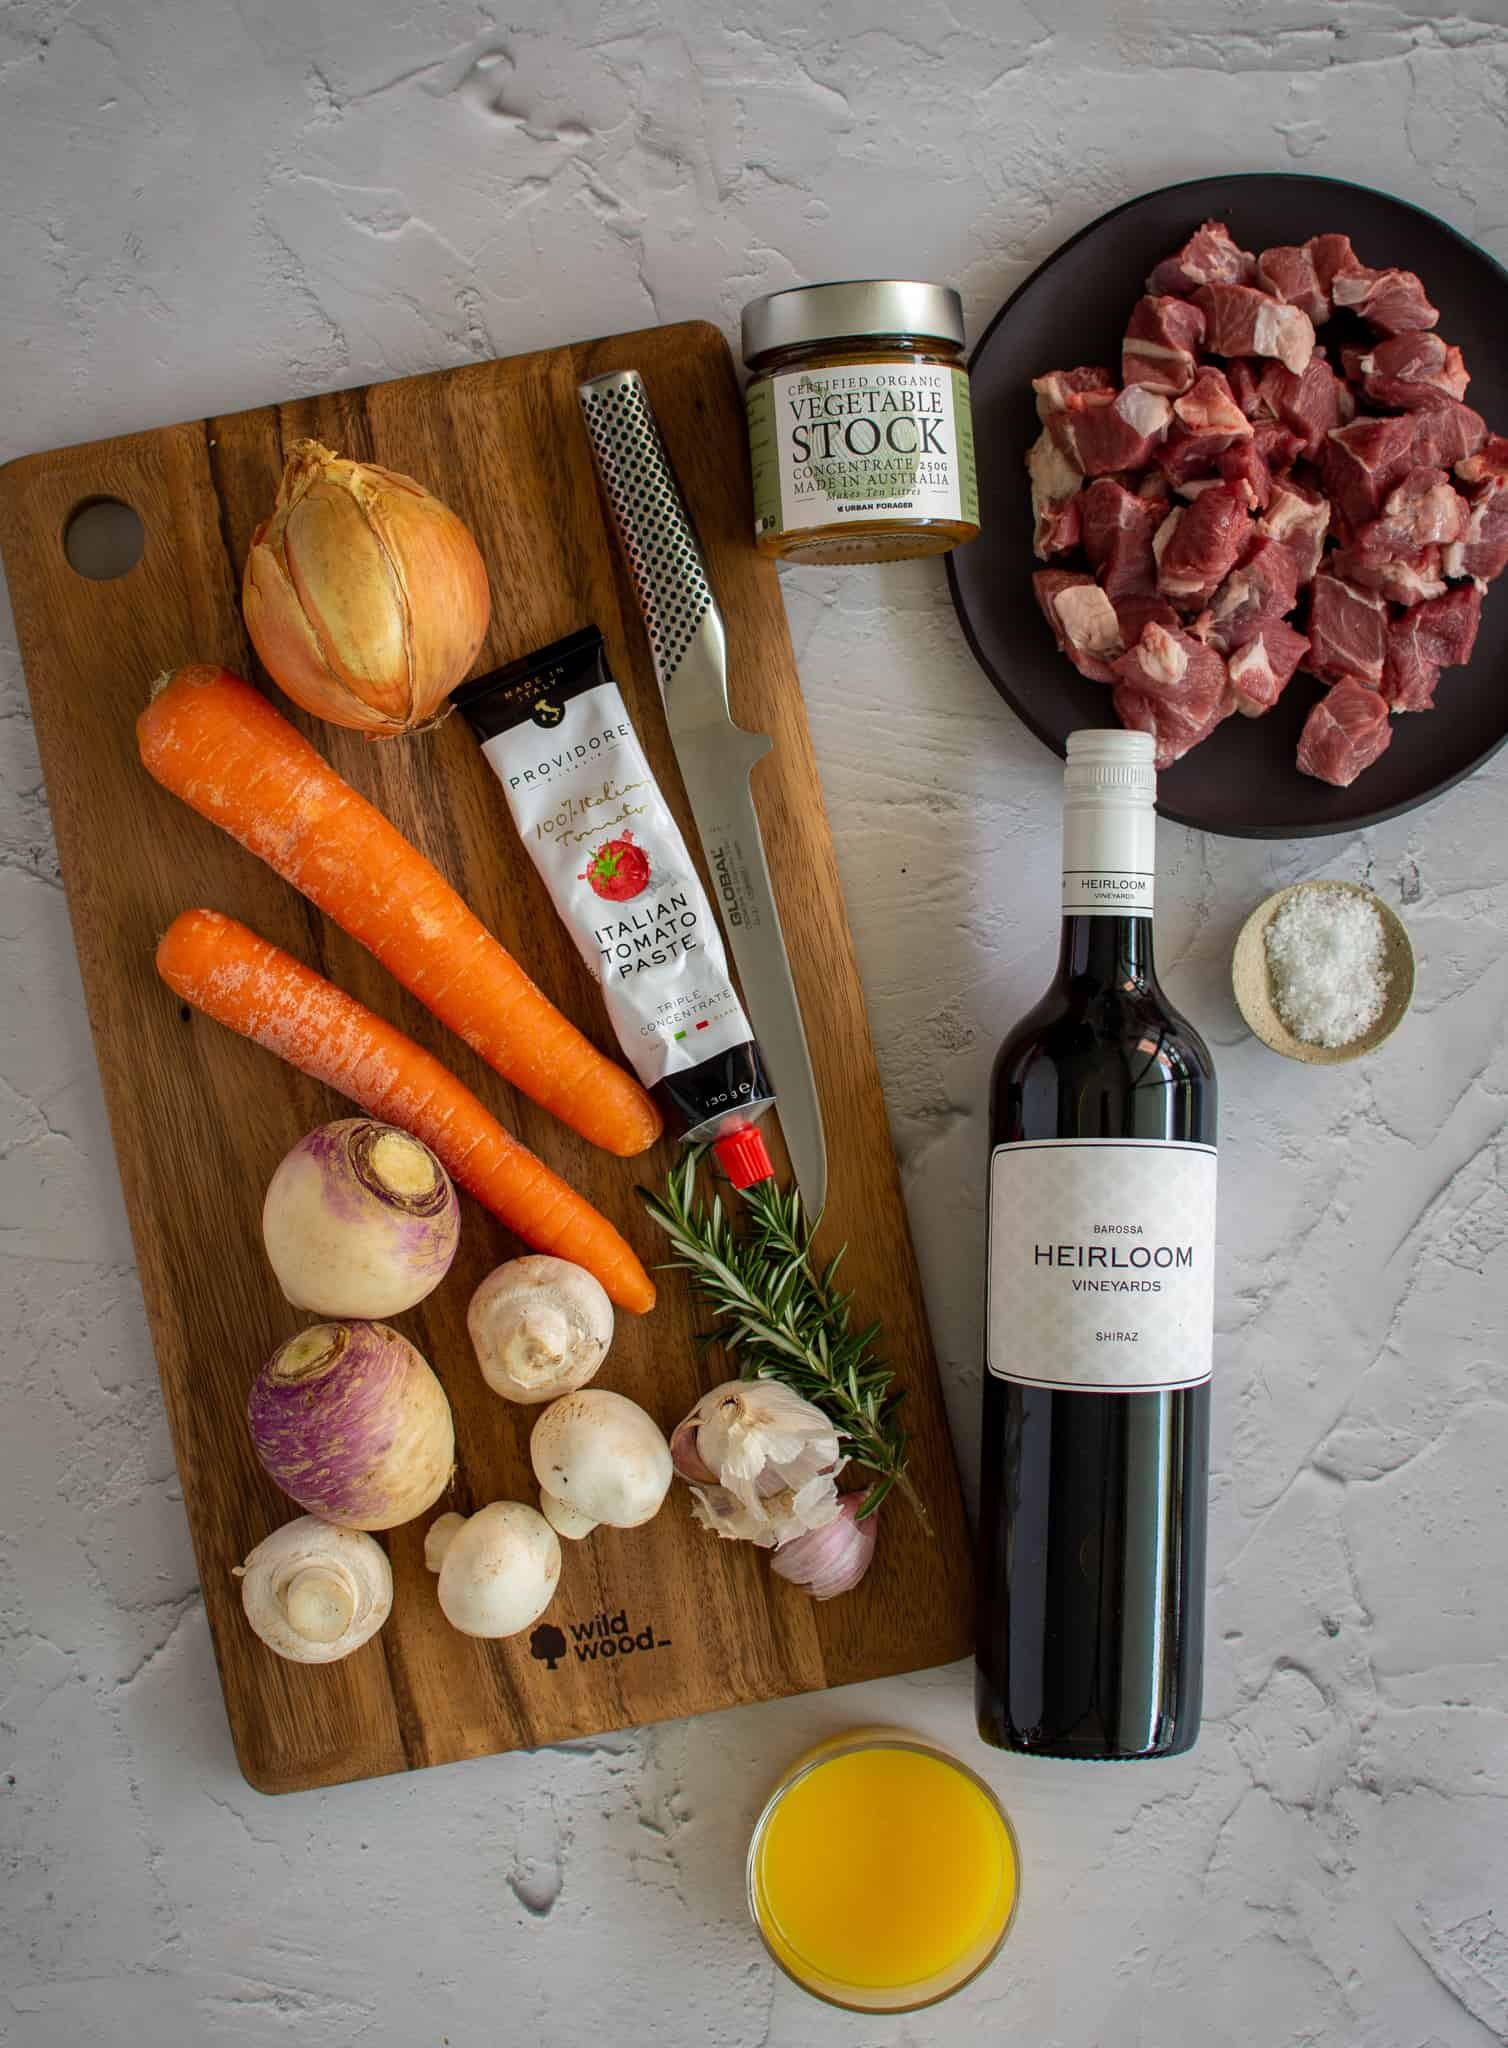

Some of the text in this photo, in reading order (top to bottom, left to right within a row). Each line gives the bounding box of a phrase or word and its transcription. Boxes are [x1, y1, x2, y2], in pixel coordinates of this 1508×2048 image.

[788, 375, 942, 396] CERTIFIED ORGANIC
[789, 390, 944, 421] VEGETABLE
[792, 416, 947, 463] STOCK
[793, 457, 948, 480] CONCENTRATE 250G
[793, 472, 949, 496] MADE IN AUSTRALIA
[844, 502, 874, 513] URBAN
[509, 723, 630, 790] PROVIDORE
[710, 847, 743, 927] GLOBAL
[1081, 879, 1146, 889] HEIRLOOM
[594, 893, 688, 945] ITALIAN
[600, 911, 697, 965] TOMATO
[619, 934, 697, 979] PASTE
[640, 989, 731, 1037] CONCENTRATE
[657, 989, 701, 1014] TRIPLE
[1093, 1224, 1144, 1235] BAROSSA
[1034, 1244, 1193, 1268] HEIRLOOM
[1072, 1279, 1162, 1292] VINEYARDS
[1095, 1331, 1139, 1343] SHIRAZ
[569, 1609, 629, 1641] wild
